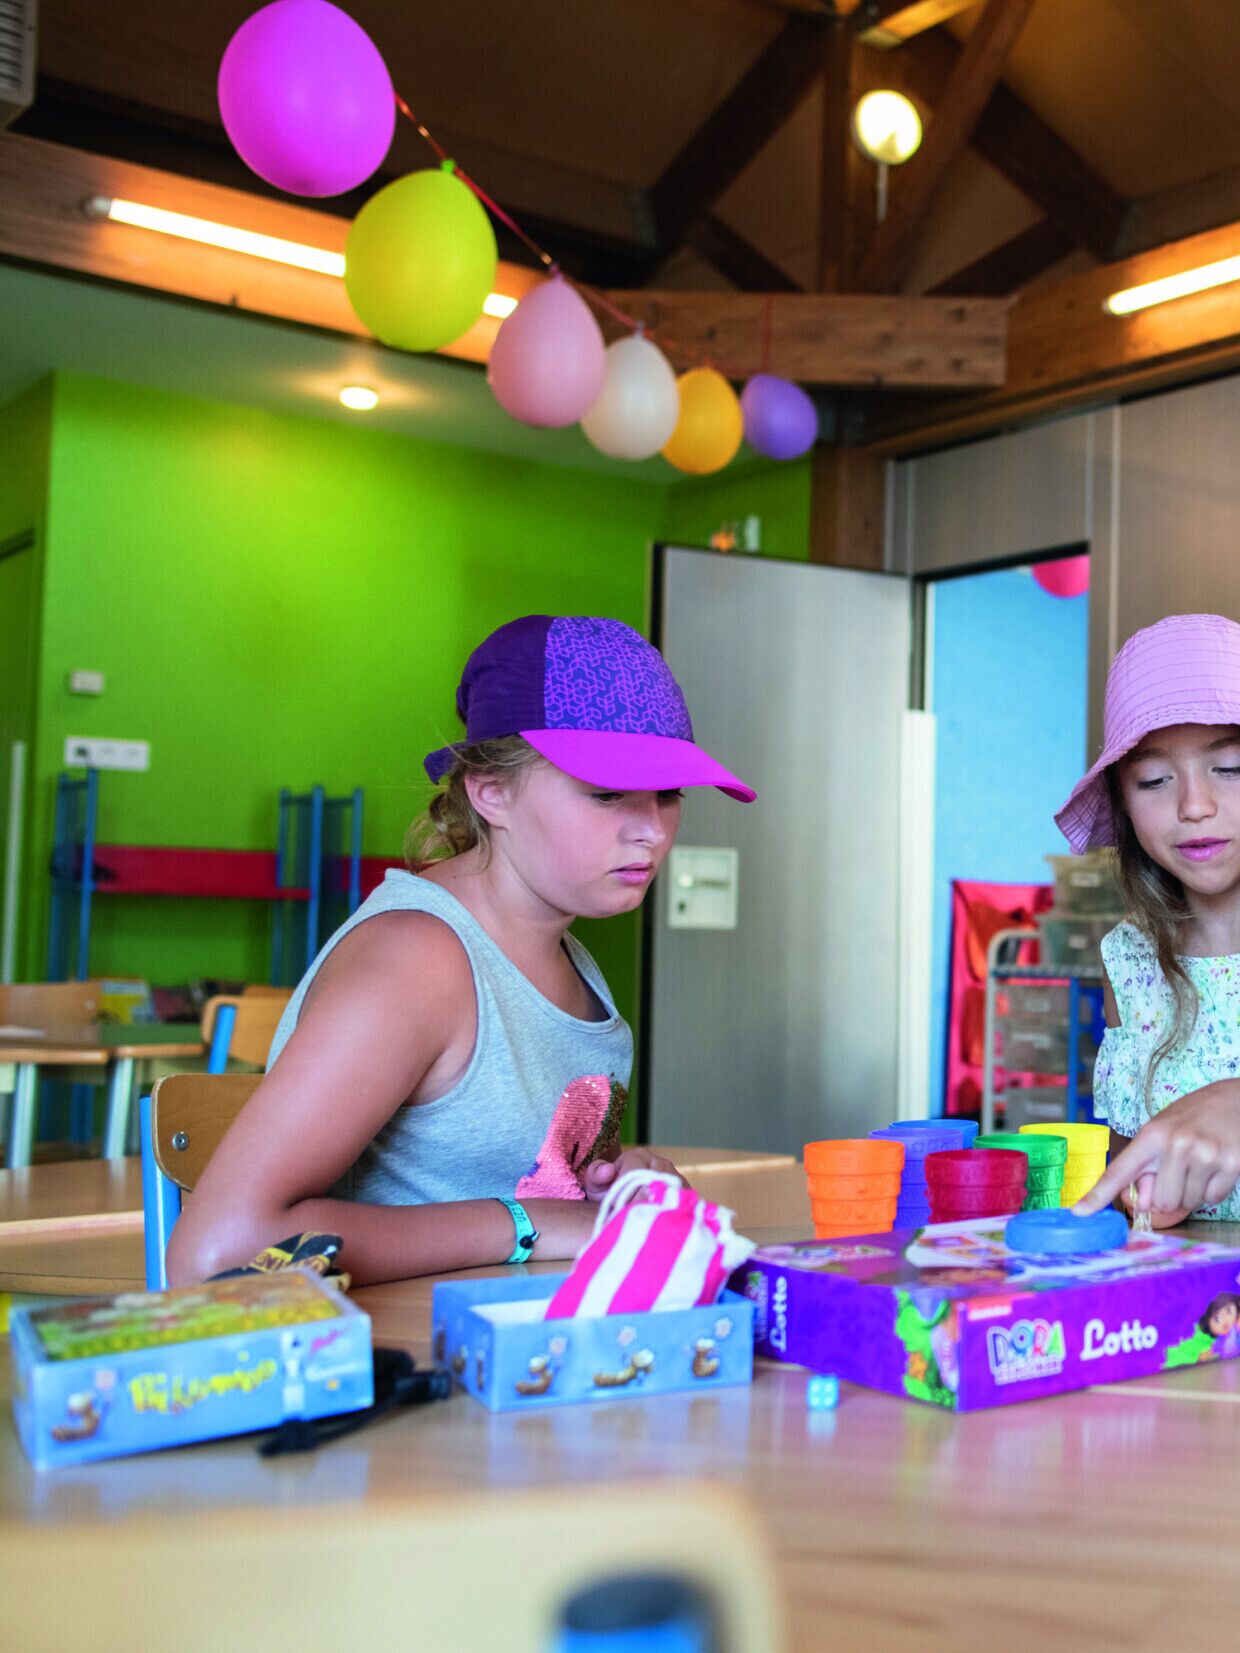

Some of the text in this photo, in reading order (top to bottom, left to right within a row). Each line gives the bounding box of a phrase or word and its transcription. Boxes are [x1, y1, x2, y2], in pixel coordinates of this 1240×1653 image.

[769, 1276, 787, 1353] Lotto
[1080, 1318, 1159, 1361] Lotto
[989, 1319, 1066, 1370] DORA
